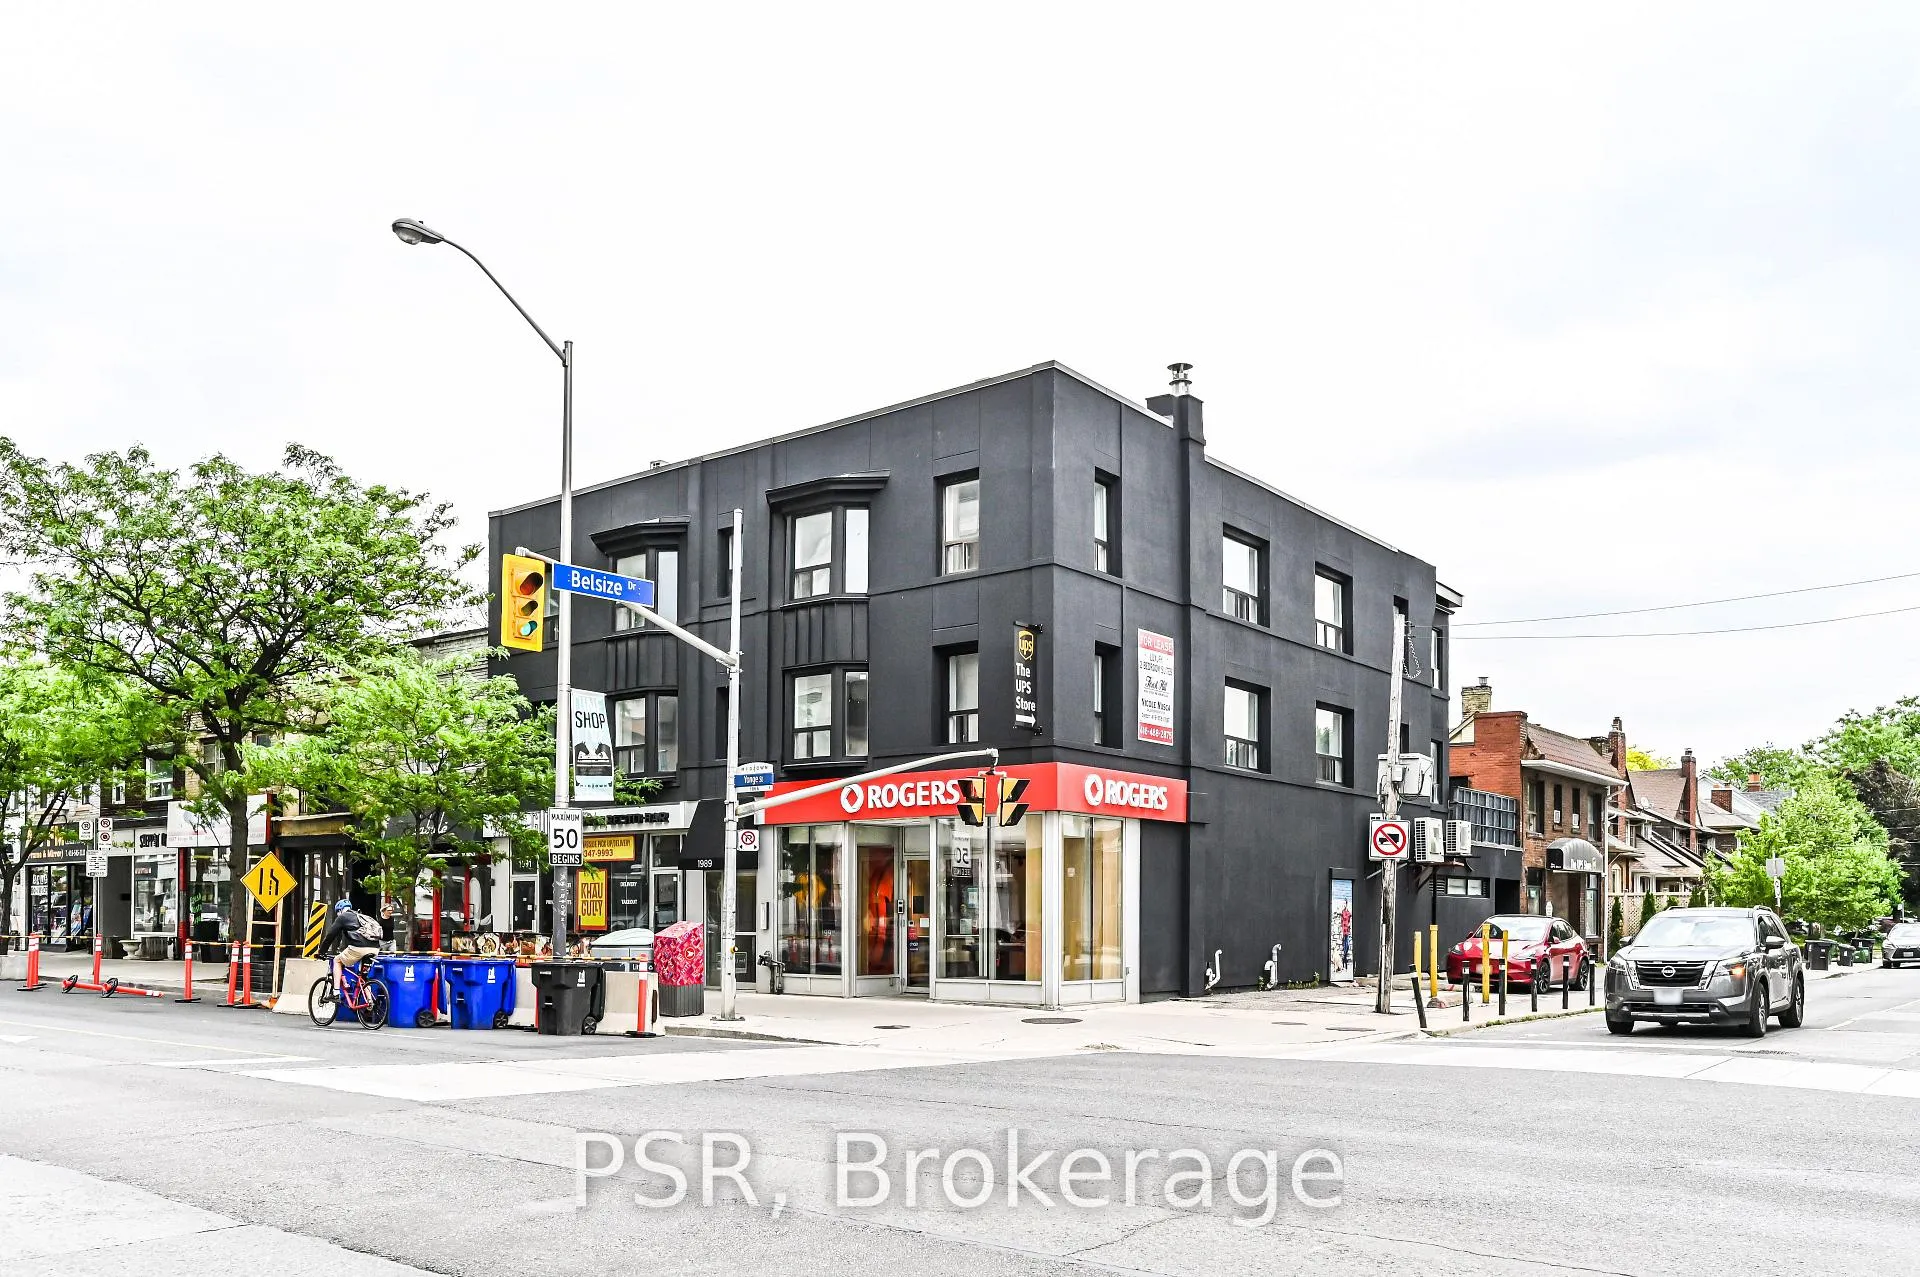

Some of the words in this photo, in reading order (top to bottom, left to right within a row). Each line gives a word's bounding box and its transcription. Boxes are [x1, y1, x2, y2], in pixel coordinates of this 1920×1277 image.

[571, 570, 623, 596] Belsize
[627, 580, 637, 591] Dr
[1019, 640, 1033, 655] ups
[1015, 662, 1031, 678] The
[1015, 681, 1032, 695] UPS
[1015, 696, 1036, 712] Store
[575, 711, 606, 729] SHOP
[743, 774, 758, 786] Yonge
[867, 779, 961, 809] ROGERS
[1104, 781, 1168, 811] ROGERS
[551, 813, 580, 822] MAXIMUM
[553, 828, 578, 849] 50
[552, 854, 580, 865] BEGINS
[697, 859, 713, 868] 1989
[581, 882, 603, 899] KHAU
